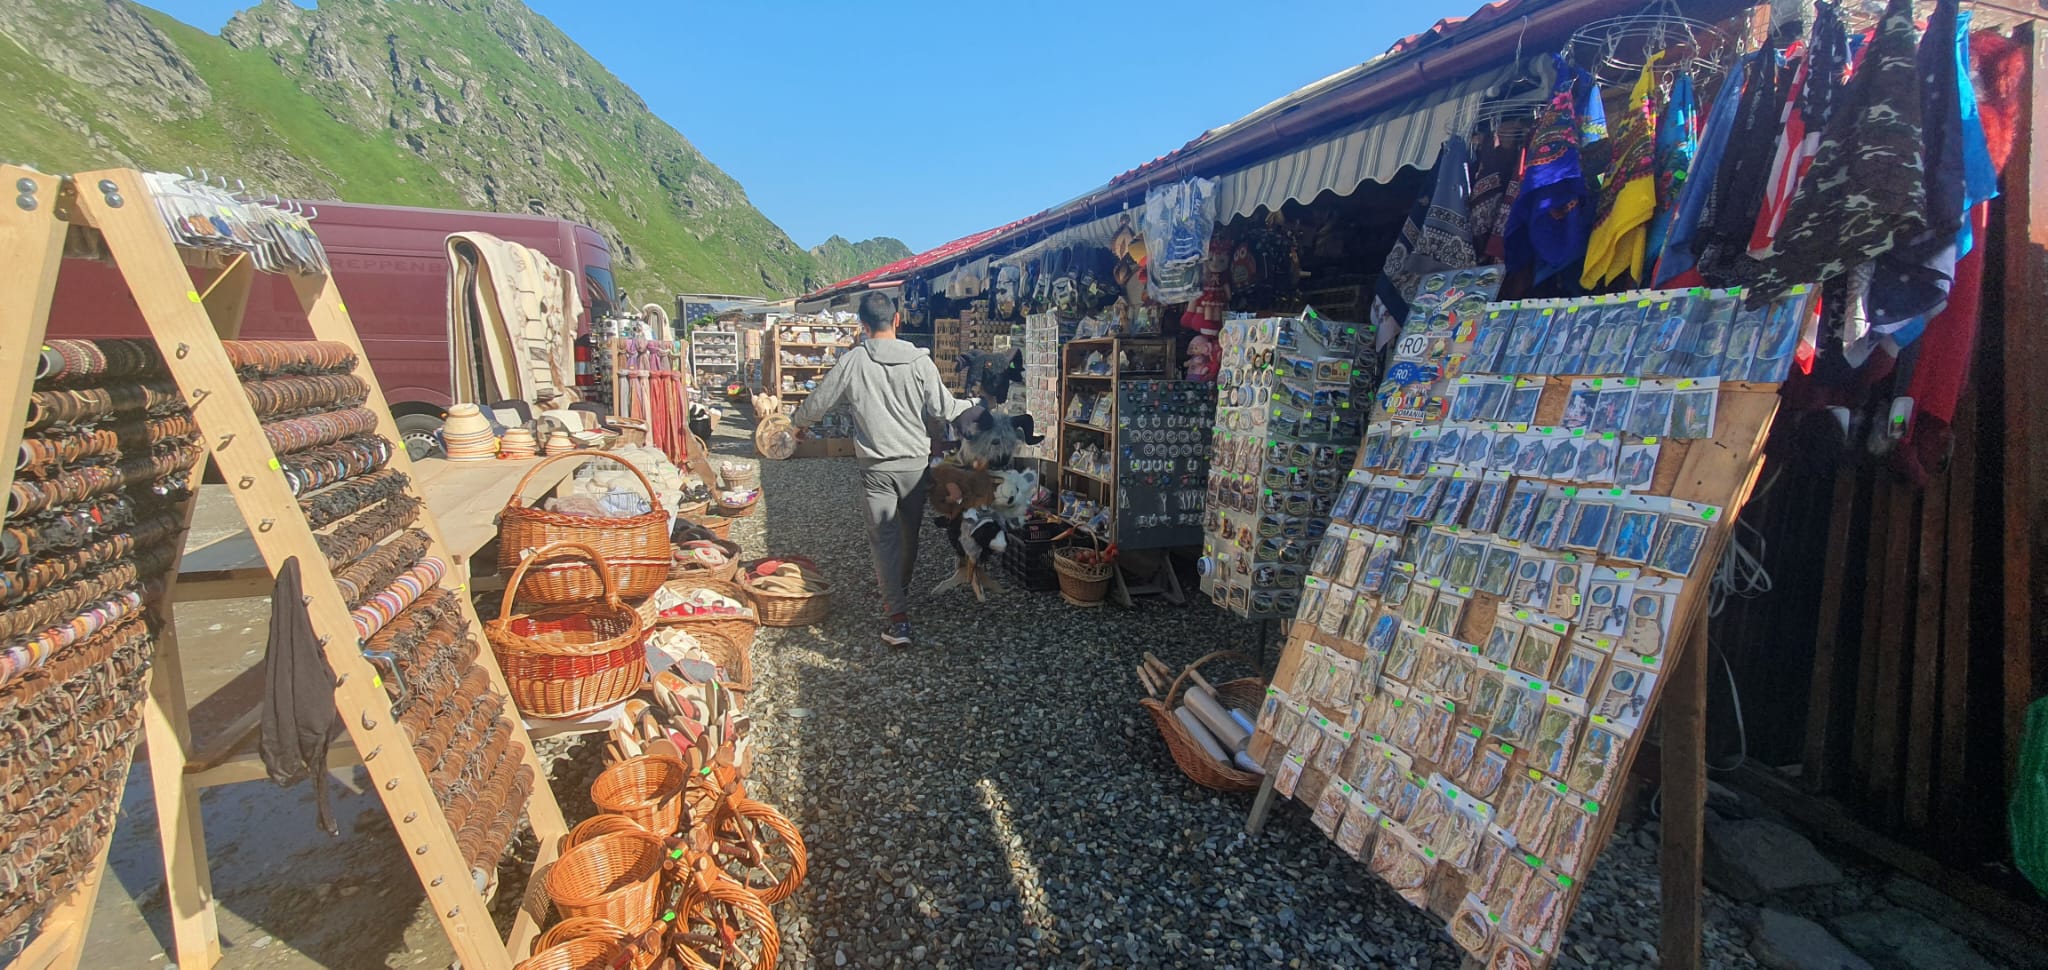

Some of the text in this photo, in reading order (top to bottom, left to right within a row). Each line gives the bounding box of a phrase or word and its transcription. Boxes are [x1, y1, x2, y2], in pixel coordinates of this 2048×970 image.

[1456, 326, 1472, 336] RO
[1401, 337, 1424, 354] RO
[1395, 368, 1408, 380] RO
[1385, 396, 1402, 408] RO
